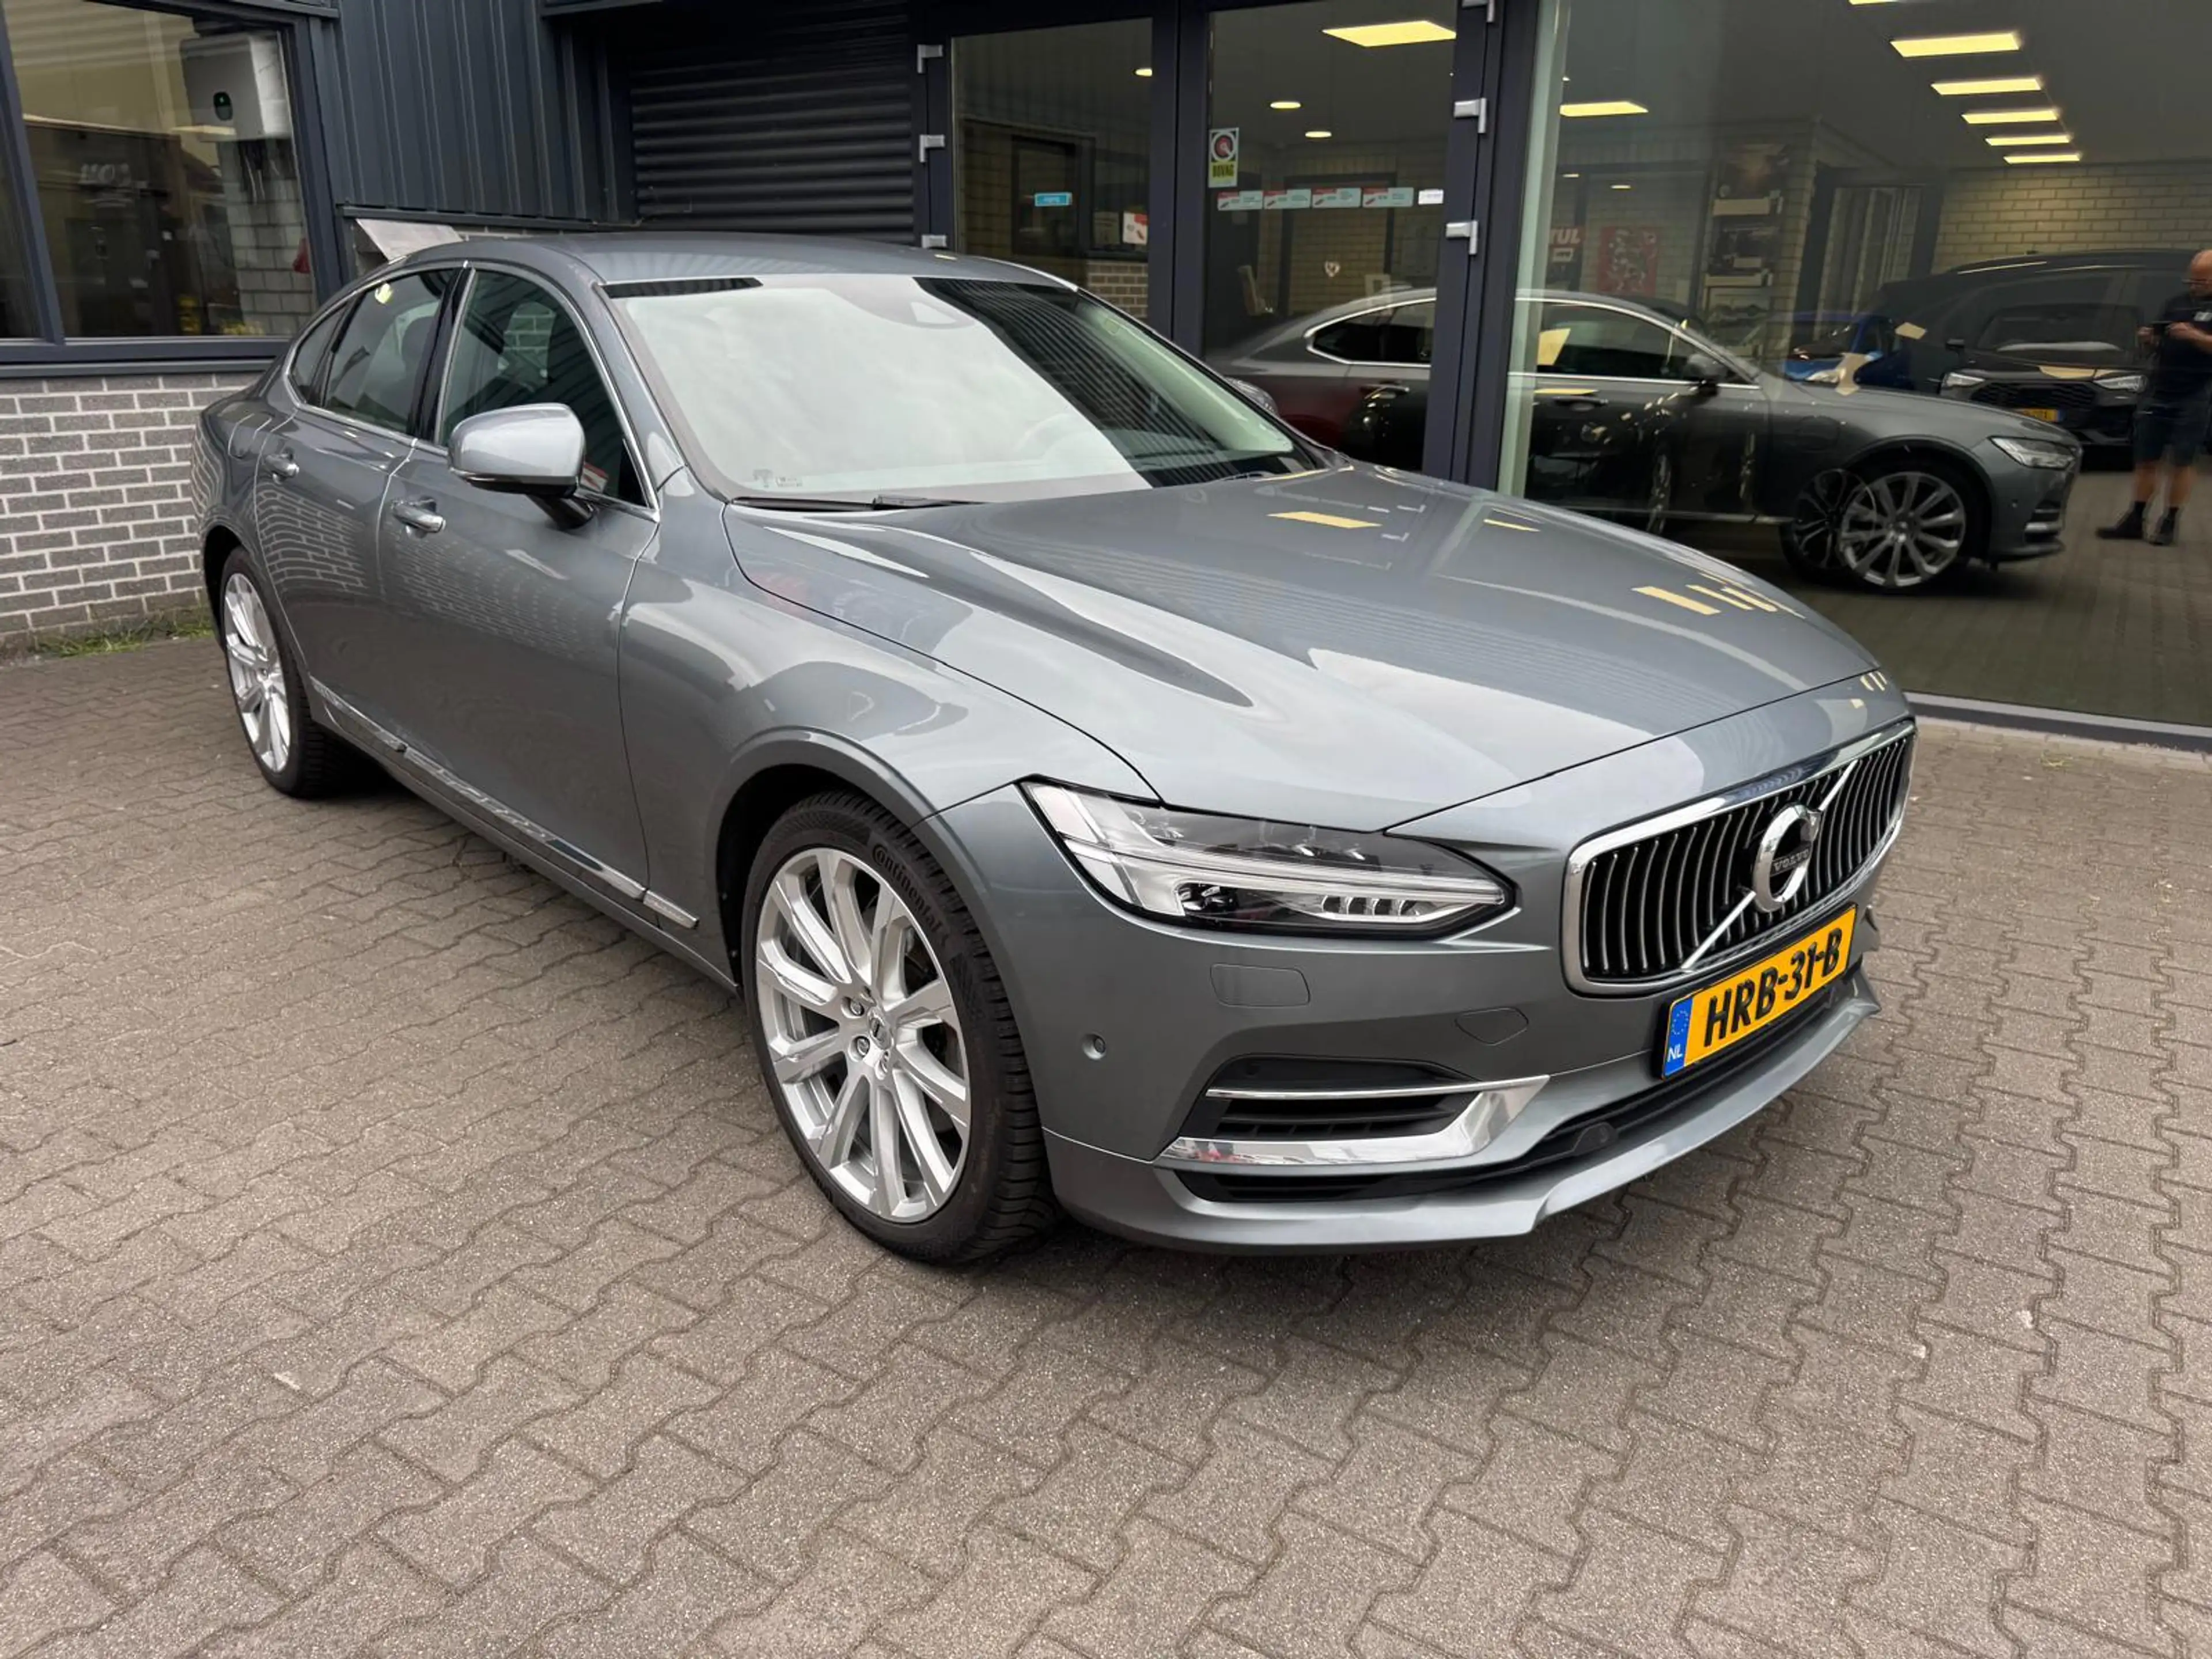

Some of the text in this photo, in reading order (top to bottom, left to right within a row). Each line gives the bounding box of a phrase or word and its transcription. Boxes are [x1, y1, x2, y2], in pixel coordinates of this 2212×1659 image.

[872, 844, 943, 932] Continental
[1703, 927, 1843, 1047] HRB-31-B
[1667, 1043, 1683, 1062] NL
